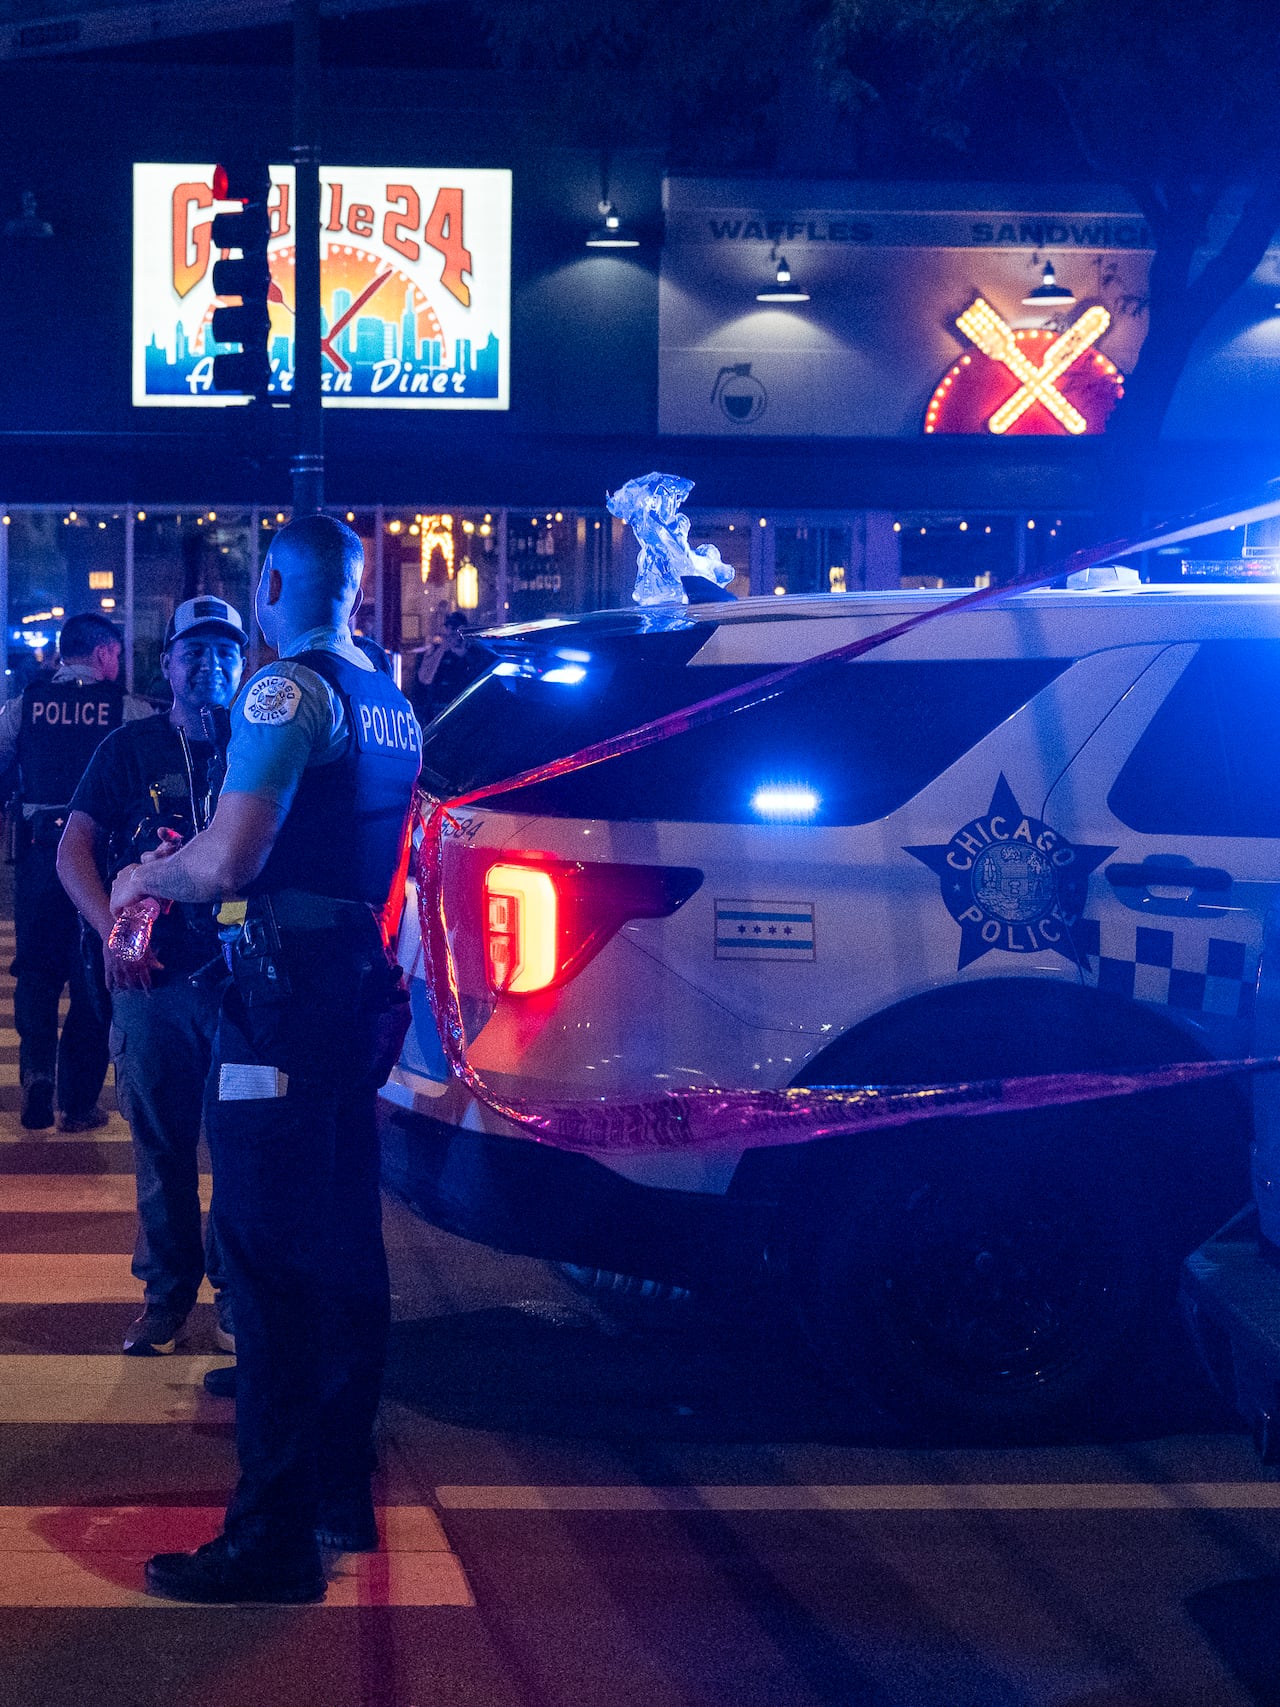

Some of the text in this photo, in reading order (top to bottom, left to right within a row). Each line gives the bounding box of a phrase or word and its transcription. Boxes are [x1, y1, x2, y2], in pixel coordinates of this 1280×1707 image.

[708, 218, 874, 242] WAFFLES
[970, 222, 1150, 246] SANDWIC
[371, 358, 466, 394] Diner
[252, 678, 295, 700] CHICAGO
[32, 701, 110, 726] POLICE
[248, 704, 288, 721] POLICE
[359, 703, 418, 752] POLICE
[946, 815, 1075, 871] CHICAGO
[958, 904, 1076, 950] POLICE
